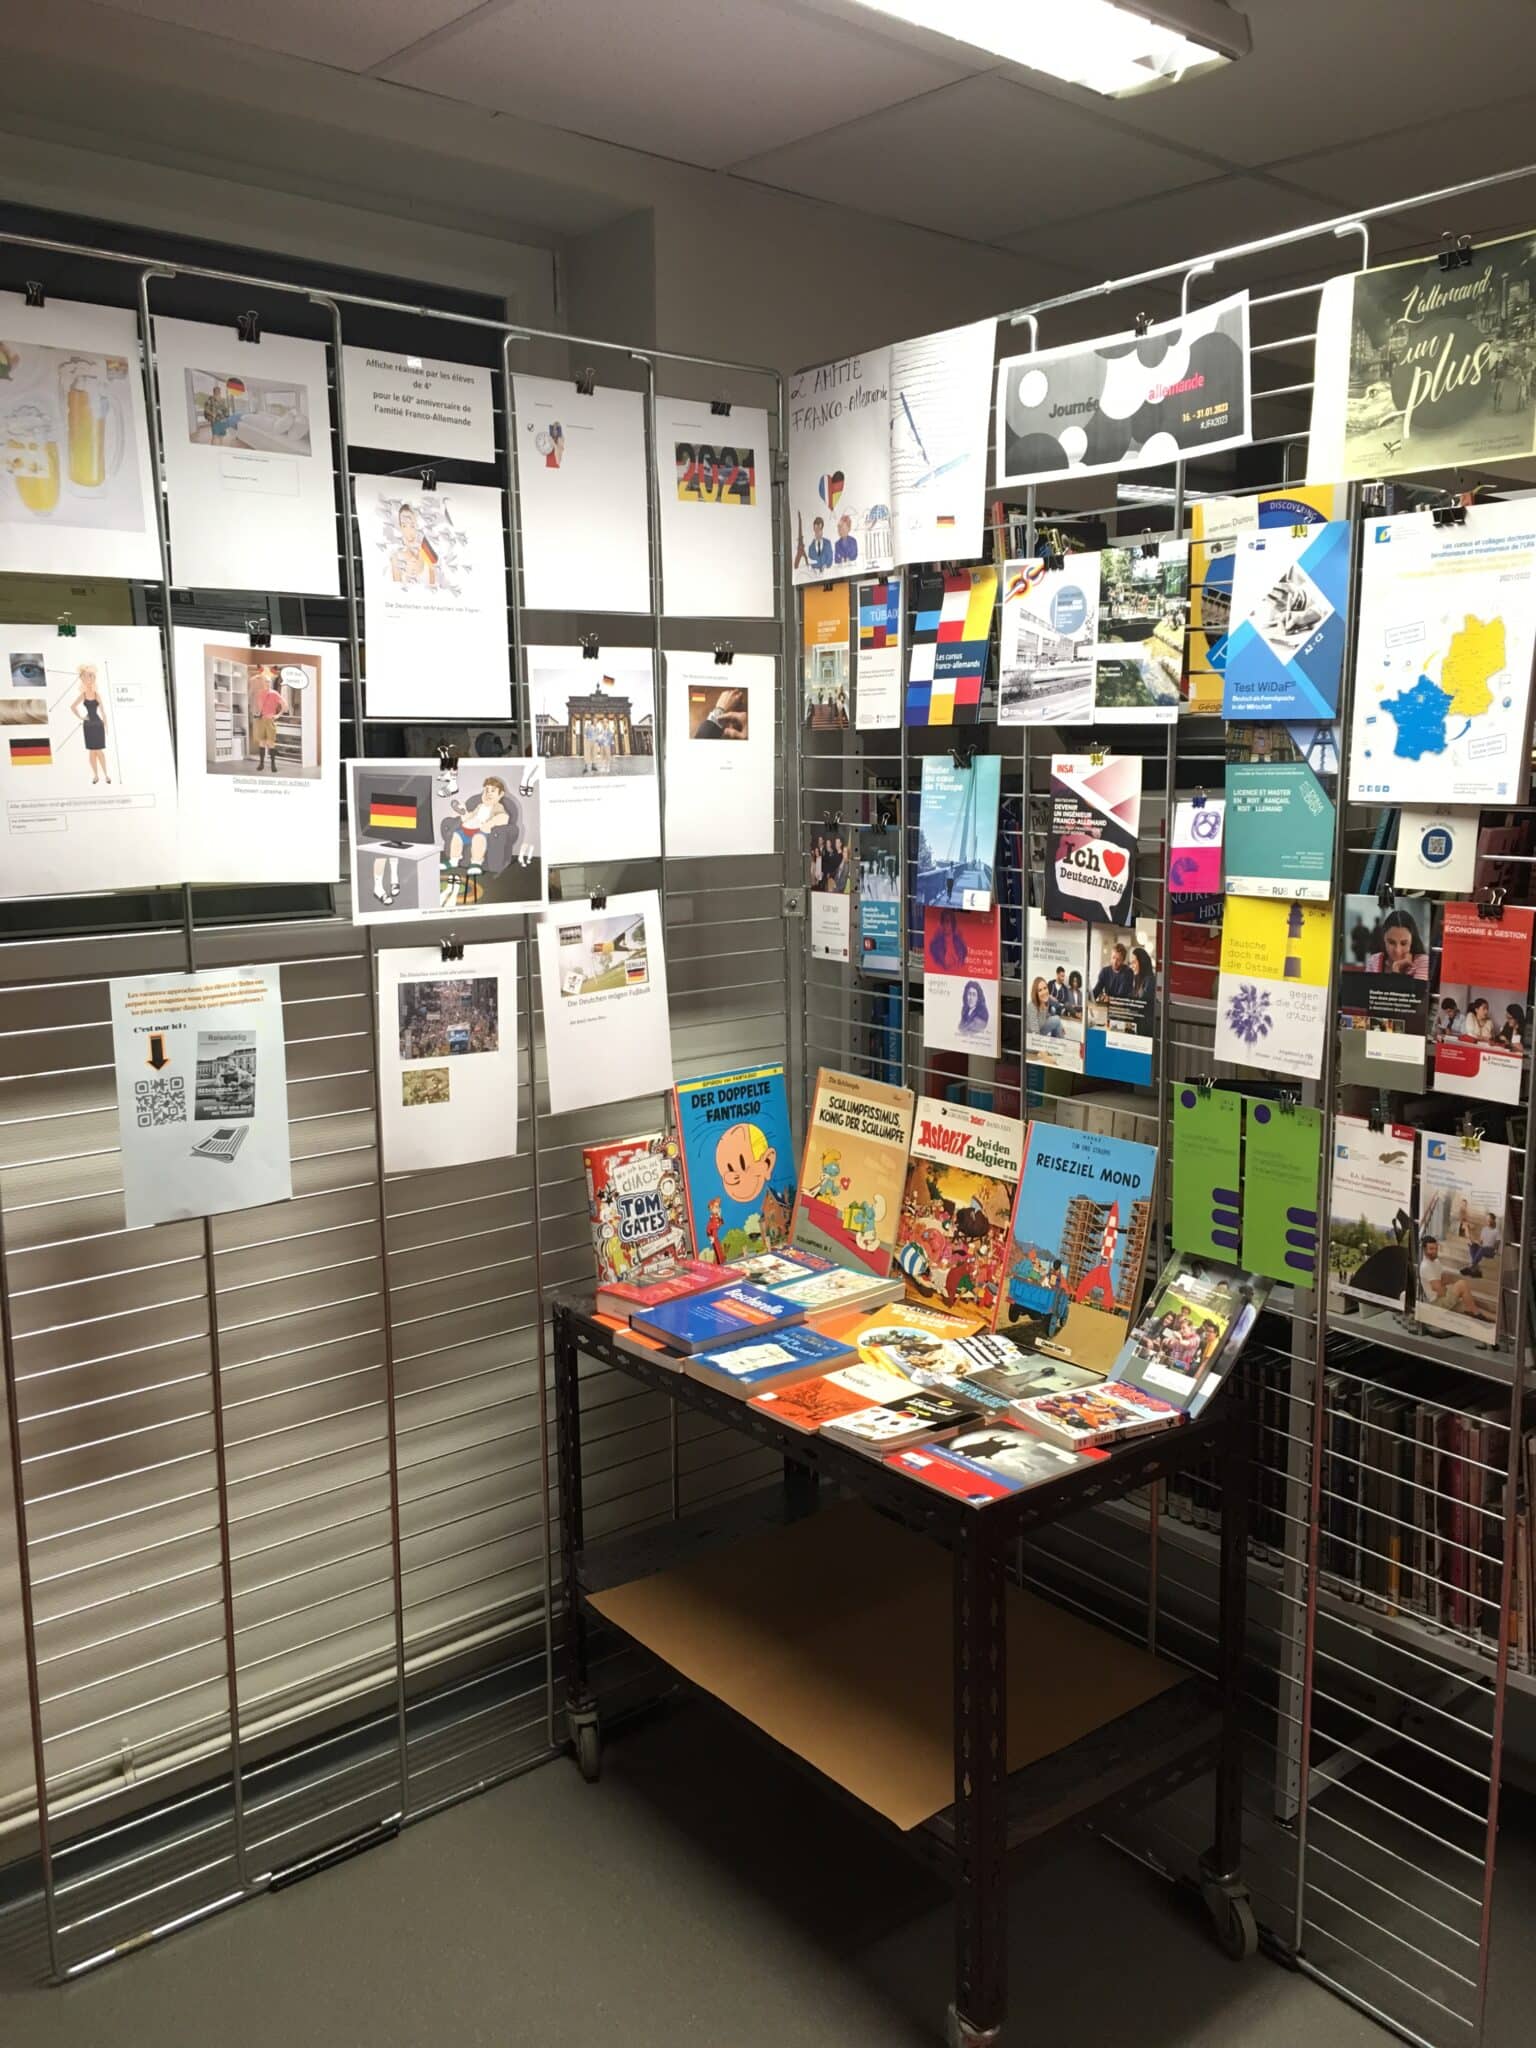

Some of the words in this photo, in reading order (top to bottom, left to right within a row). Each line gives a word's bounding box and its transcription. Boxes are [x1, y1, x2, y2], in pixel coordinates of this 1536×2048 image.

[1400, 335, 1440, 366] un
[366, 359, 393, 370] Affiche
[426, 370, 438, 379] par
[440, 371, 450, 380] les
[452, 373, 475, 384] élèves
[413, 381, 422, 389] de
[1148, 372, 1205, 400] allemande
[1376, 332, 1491, 440] plus
[373, 391, 391, 400] pour
[393, 392, 400, 401] le
[416, 398, 460, 411] anniversaire
[462, 404, 471, 412] de
[1234, 682, 1255, 692] Test
[1056, 764, 1074, 773] INSA
[1062, 841, 1100, 872] Ich
[1060, 867, 1123, 895] DeutschINSA
[1494, 929, 1528, 939] GESTION
[691, 1092, 715, 1109] DER
[718, 1081, 771, 1104] DOPPELTE
[706, 1101, 761, 1123] FANTASIO
[829, 1097, 900, 1128] SCHLUMPFISSIMUS,
[844, 1116, 860, 1131] DER
[966, 1145, 1018, 1171] Belgiern
[976, 1136, 992, 1150] bei
[992, 1140, 1010, 1155] den
[1036, 1152, 1095, 1179] REISEZIEL
[1100, 1168, 1141, 1189] MOND
[621, 1193, 660, 1218] TOM
[622, 1212, 665, 1238] GATES
